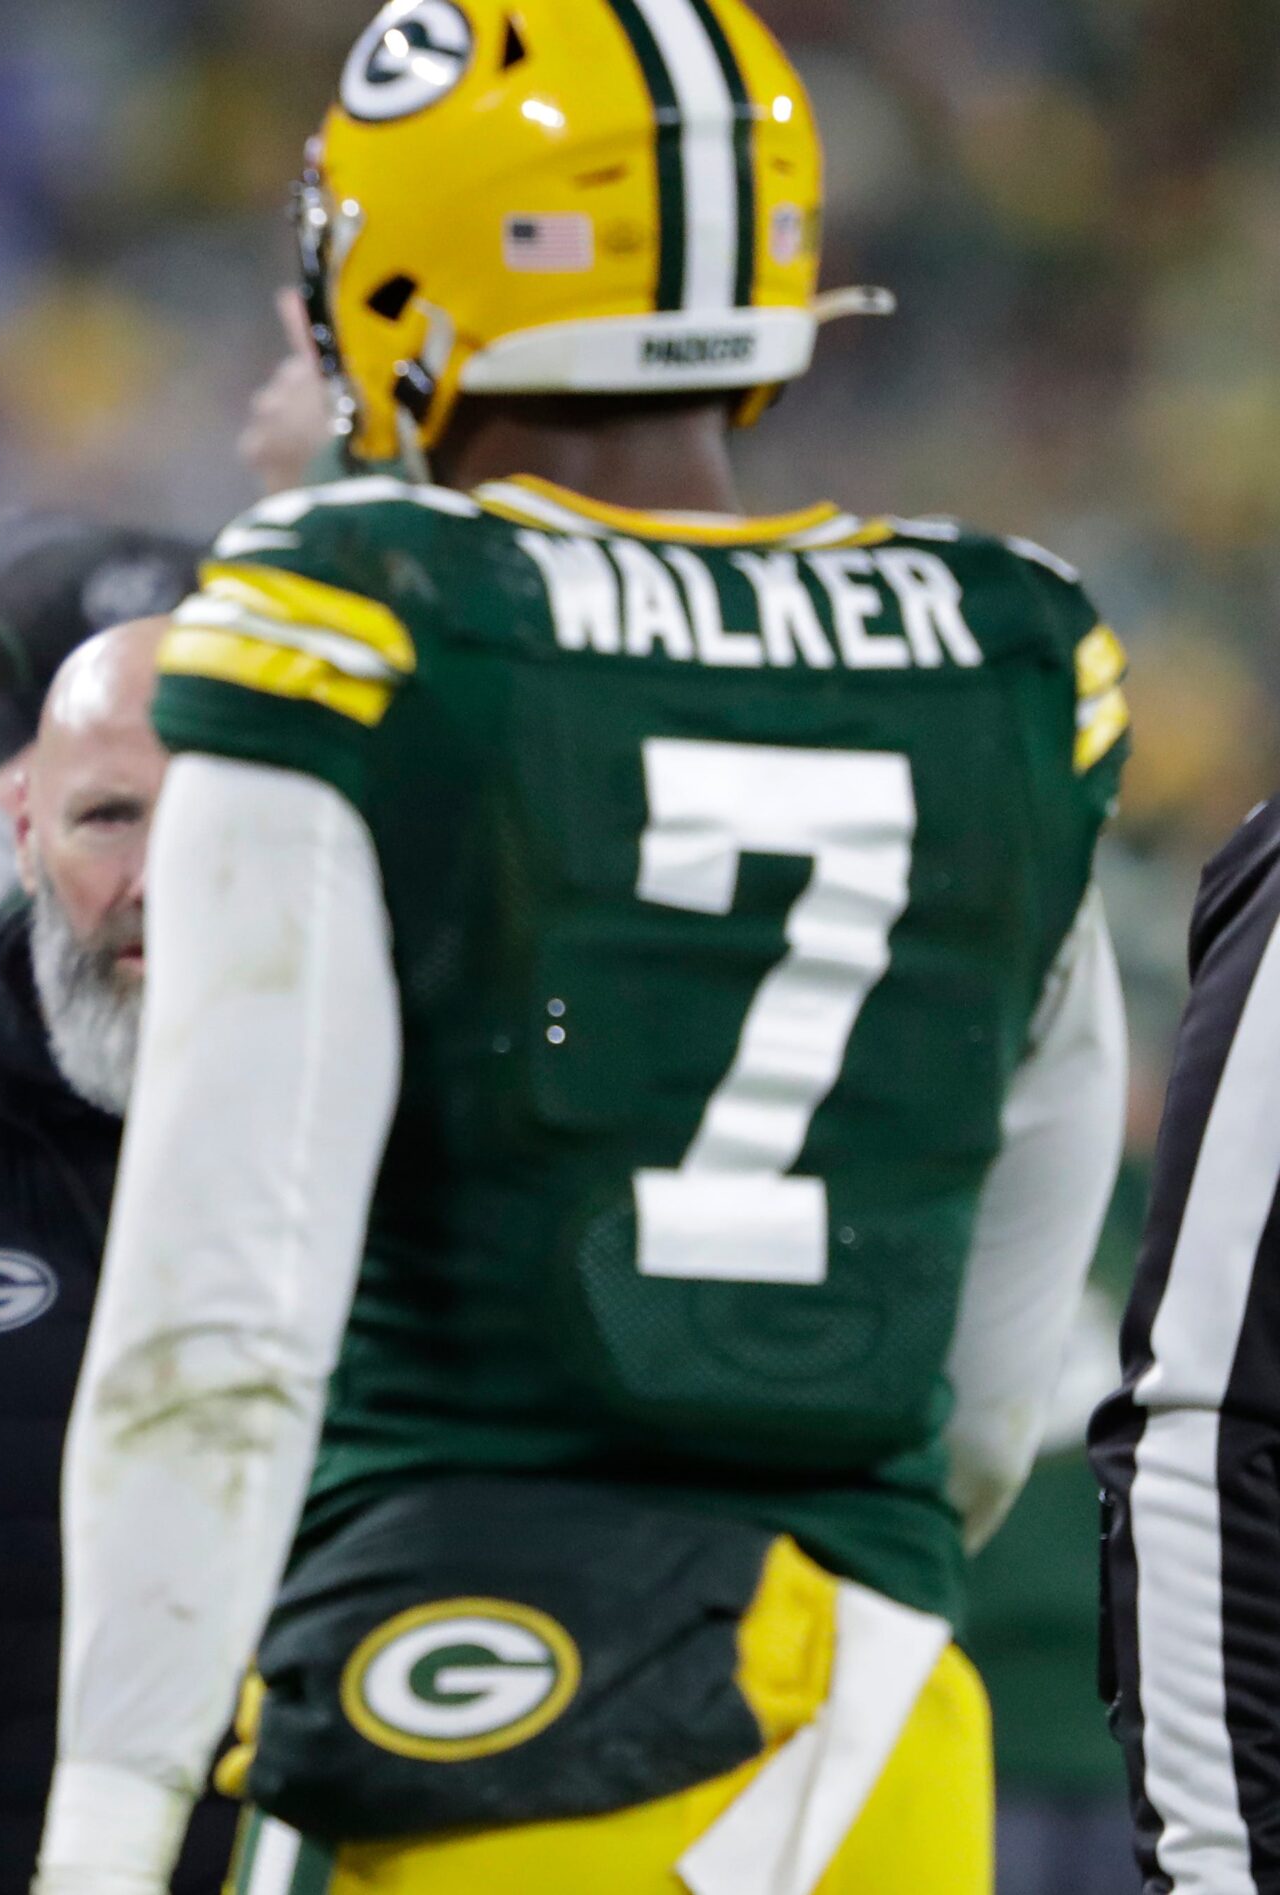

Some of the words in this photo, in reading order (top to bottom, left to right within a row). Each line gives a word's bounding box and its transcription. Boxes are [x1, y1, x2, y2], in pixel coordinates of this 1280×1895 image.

[516, 526, 984, 669] WALKER
[632, 736, 917, 1285] 7
[363, 1616, 554, 1739] G
